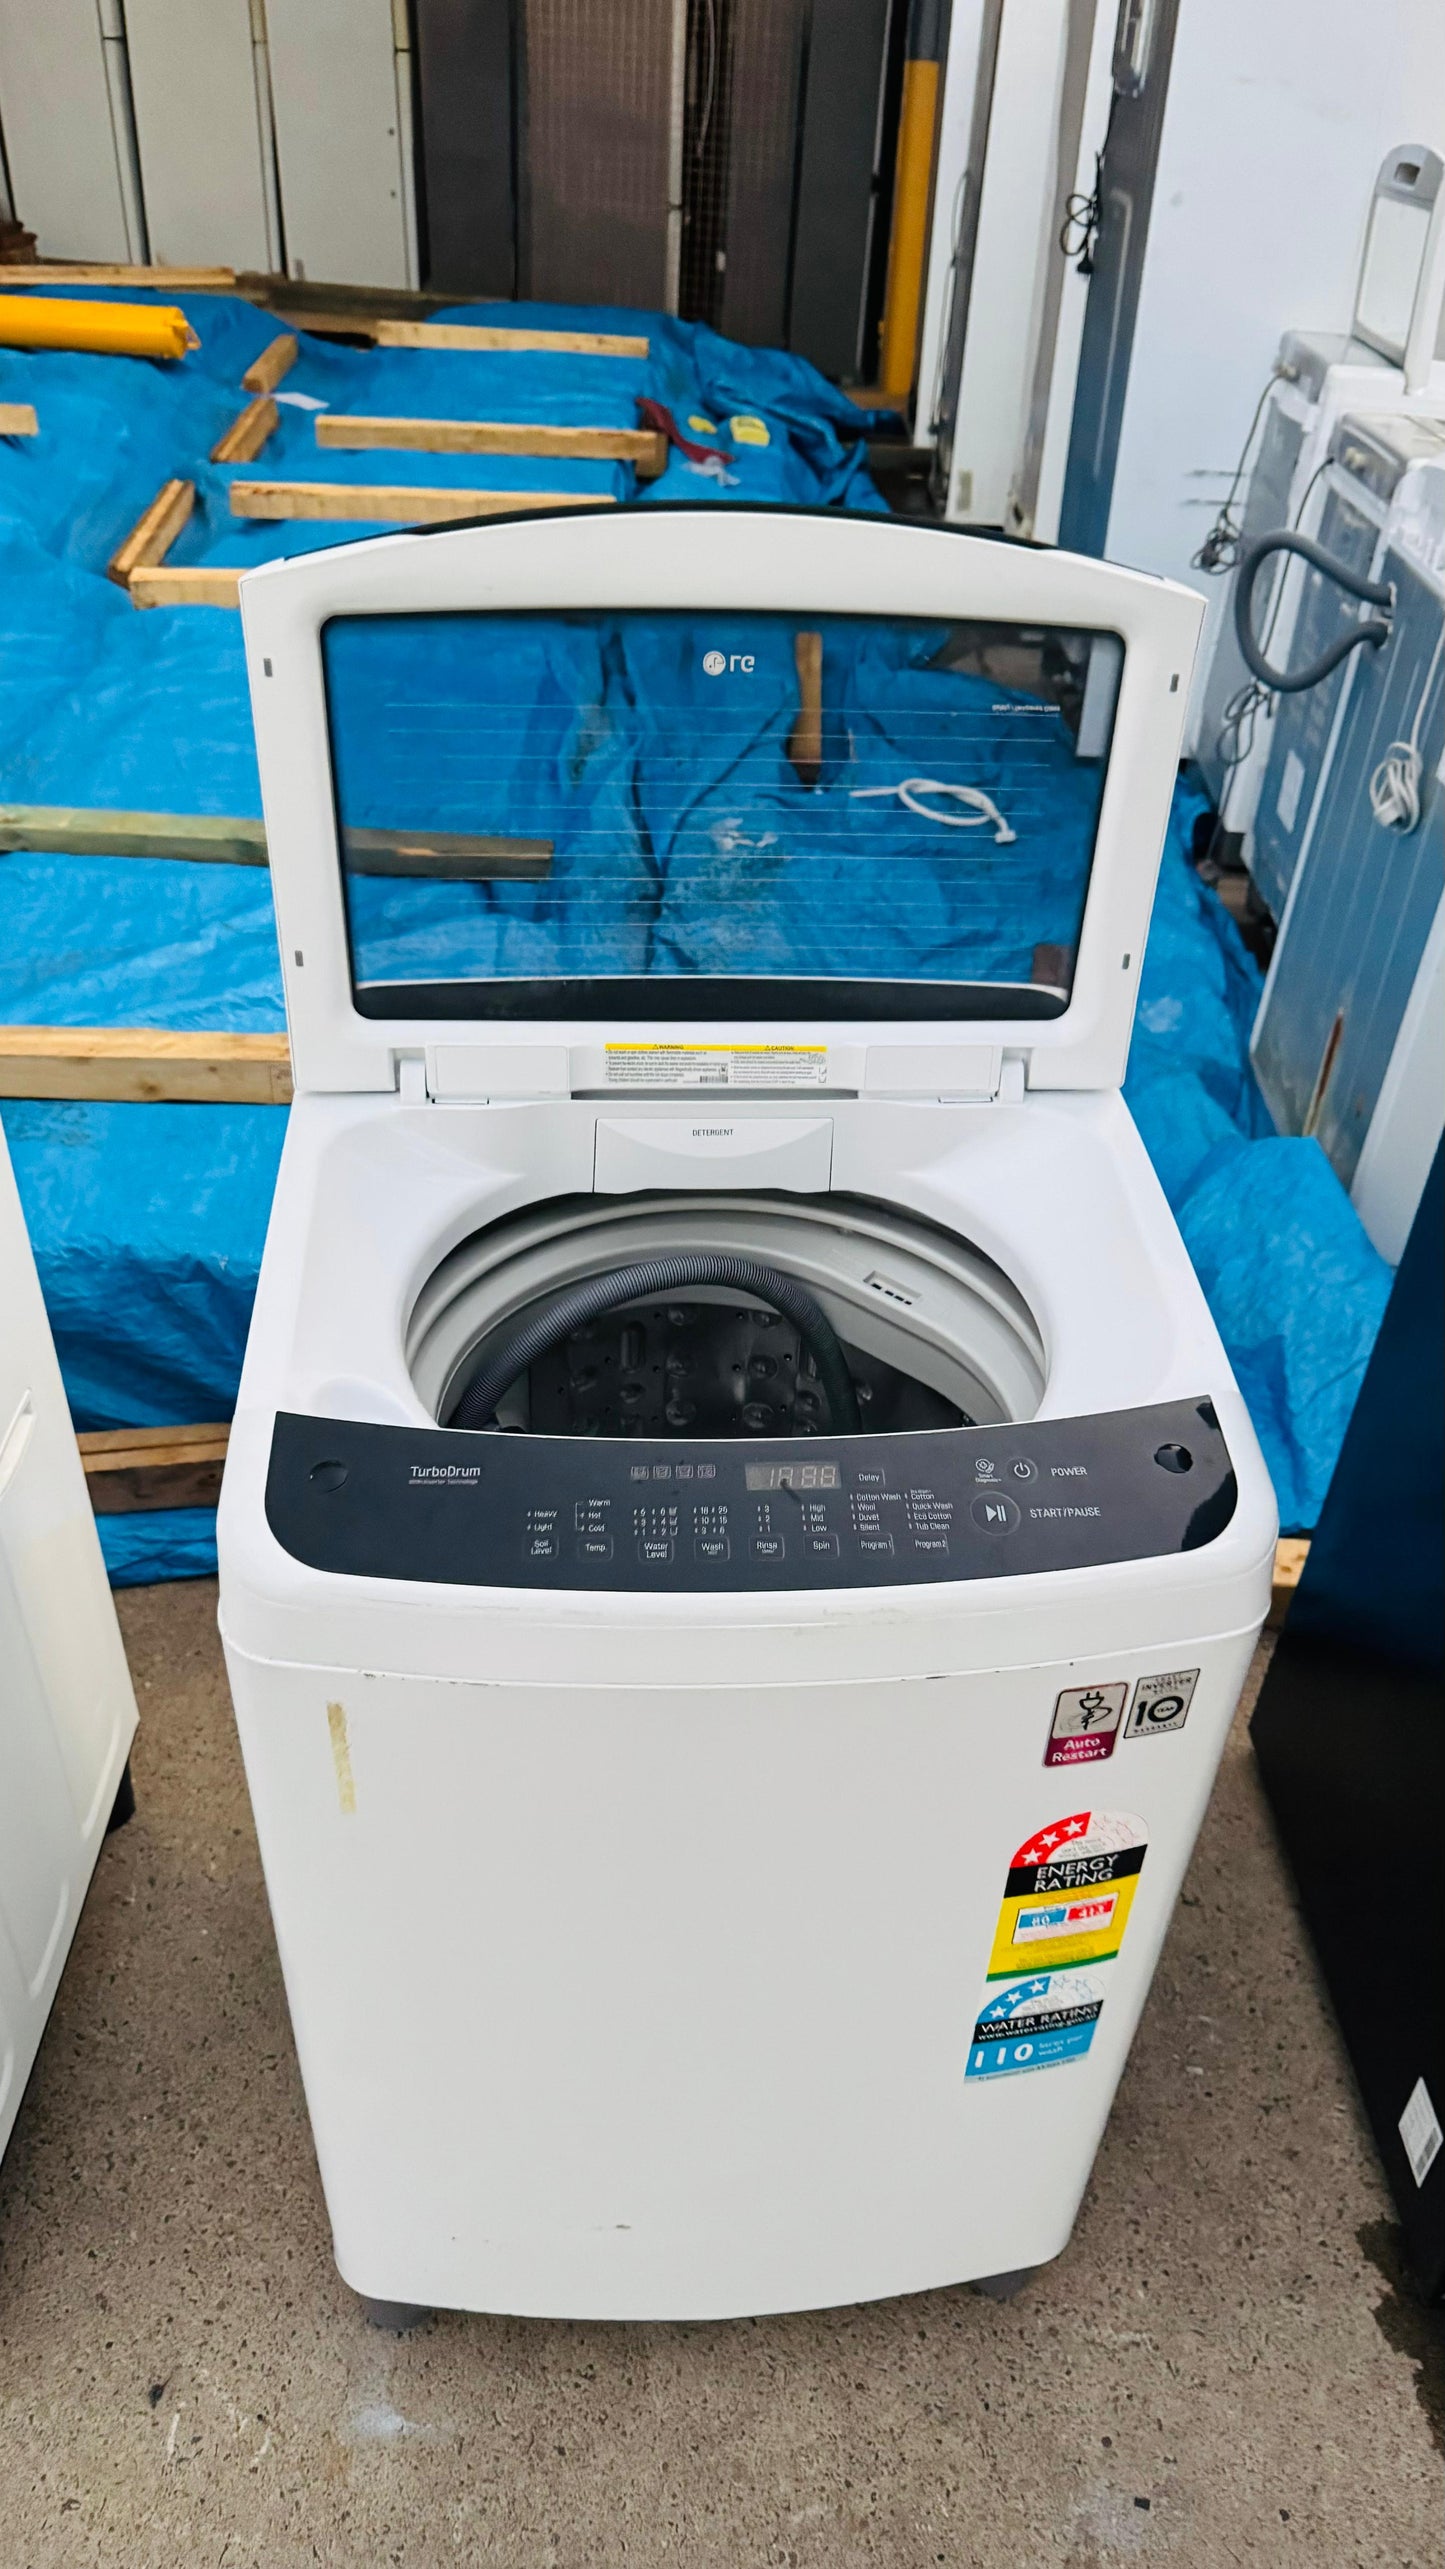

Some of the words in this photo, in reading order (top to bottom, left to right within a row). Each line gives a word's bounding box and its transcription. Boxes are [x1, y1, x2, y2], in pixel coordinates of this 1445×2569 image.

[692, 1128, 734, 1137] DETERGENT
[410, 1465, 481, 1478] TurboDrum
[1050, 1466, 1088, 1477] POWER
[858, 1473, 880, 1483] Delay
[856, 1493, 880, 1501] Cotton
[880, 1492, 902, 1501] Wash
[911, 1493, 935, 1501] Cotton
[588, 1499, 611, 1507] Warm
[857, 1503, 876, 1511] Wool
[912, 1502, 931, 1511] Quick
[932, 1502, 953, 1510] Wash
[809, 1504, 826, 1513] High
[1029, 1506, 1101, 1519] START/PAUSE
[534, 1510, 558, 1518] Heavy
[588, 1511, 602, 1519] Hot
[810, 1514, 824, 1522] Mid
[858, 1513, 880, 1521] Duvet
[913, 1512, 927, 1520] Eco
[928, 1512, 952, 1520] Cotton
[534, 1522, 553, 1532] Light
[588, 1524, 605, 1532] Cold
[811, 1524, 827, 1532] Low
[859, 1523, 880, 1531] Silent
[915, 1522, 929, 1531] Tub
[930, 1522, 950, 1530] Clean
[534, 1539, 549, 1548] Soil
[585, 1543, 606, 1553] Temp
[644, 1542, 669, 1550] Water
[701, 1542, 724, 1551] Wash
[756, 1541, 778, 1550] Rinse
[813, 1540, 830, 1551] Spin
[860, 1540, 887, 1550] Program
[915, 1539, 942, 1550] Program
[530, 1546, 552, 1556] Level
[646, 1550, 668, 1559] Level
[1135, 1696, 1184, 1727] 10
[1063, 1736, 1101, 1751] Auto
[1052, 1746, 1108, 1763] Restart
[1036, 1854, 1120, 1880] ENERGY
[1034, 1868, 1115, 1893] RATING
[981, 2016, 1035, 2034] WATER
